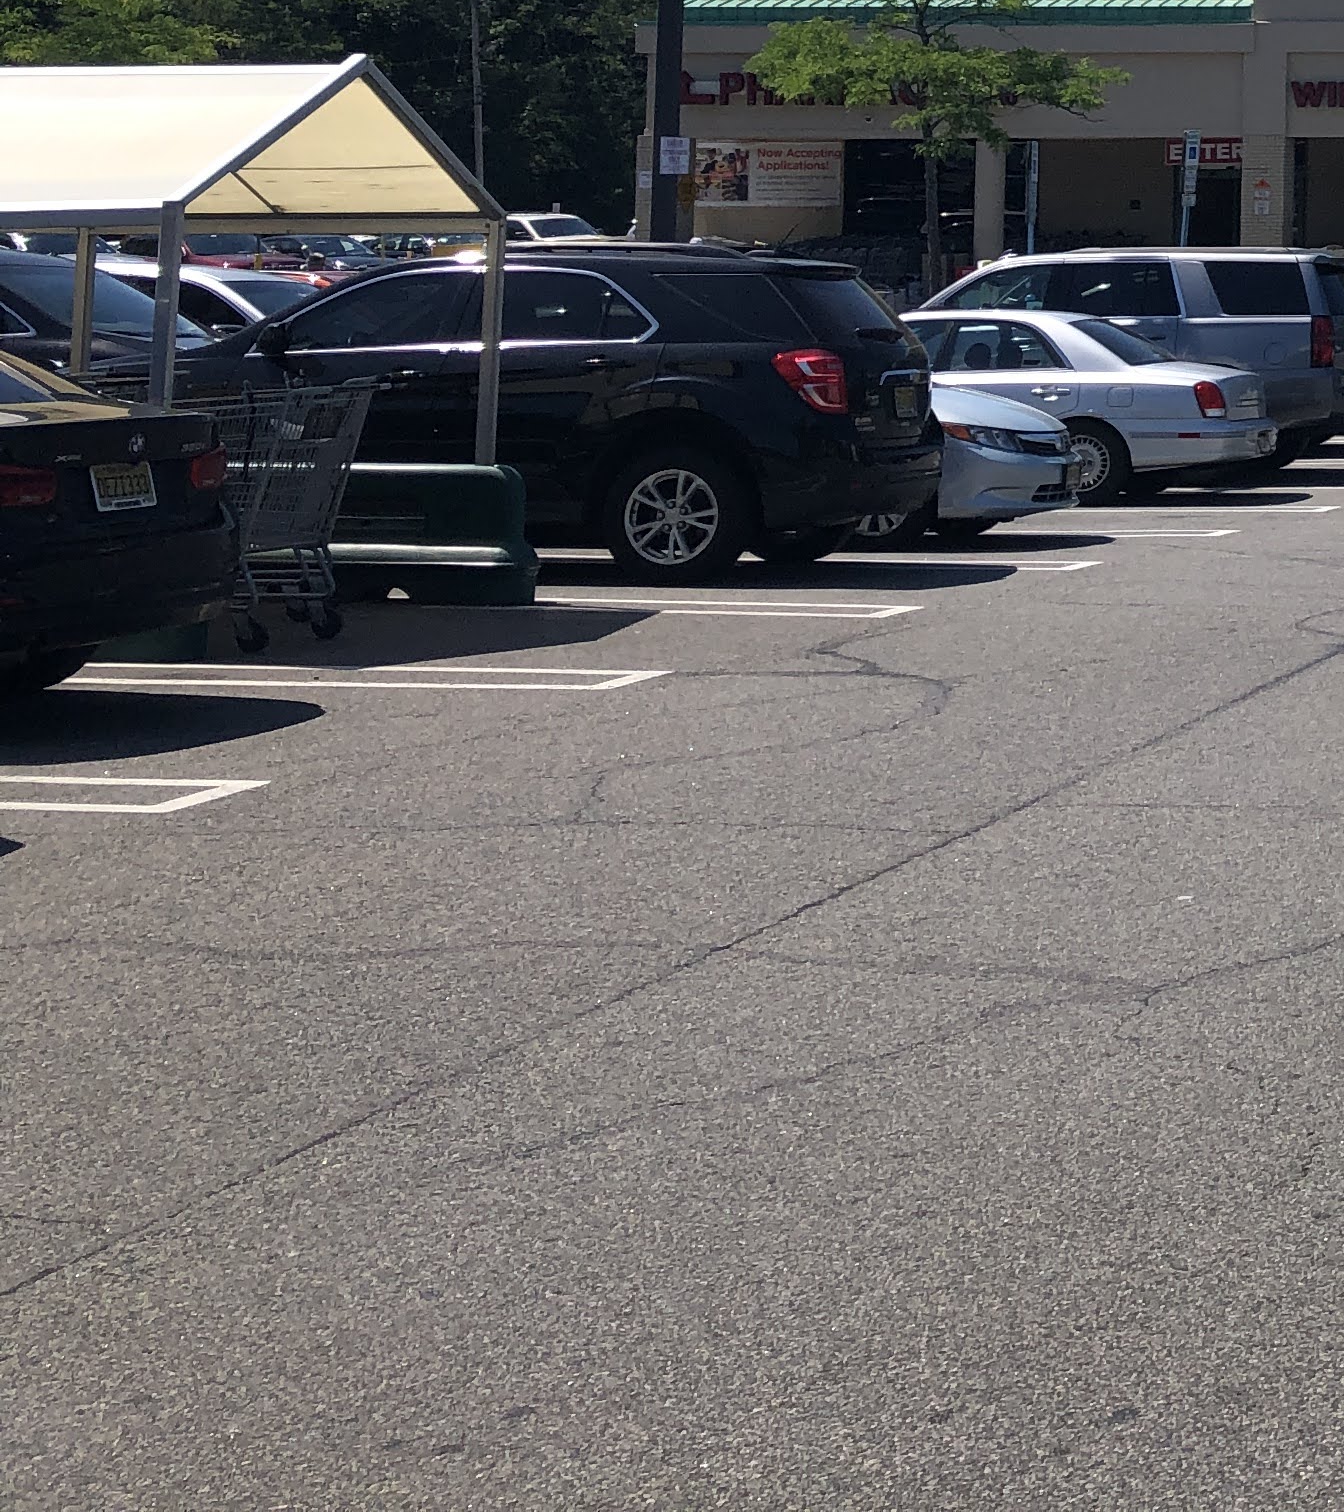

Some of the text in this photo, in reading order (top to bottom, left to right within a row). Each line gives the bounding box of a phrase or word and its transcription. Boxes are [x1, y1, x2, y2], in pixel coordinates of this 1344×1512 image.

[757, 148, 842, 159] Now Accepting
[1169, 143, 1244, 160] ETER
[757, 160, 830, 171] Applications!
